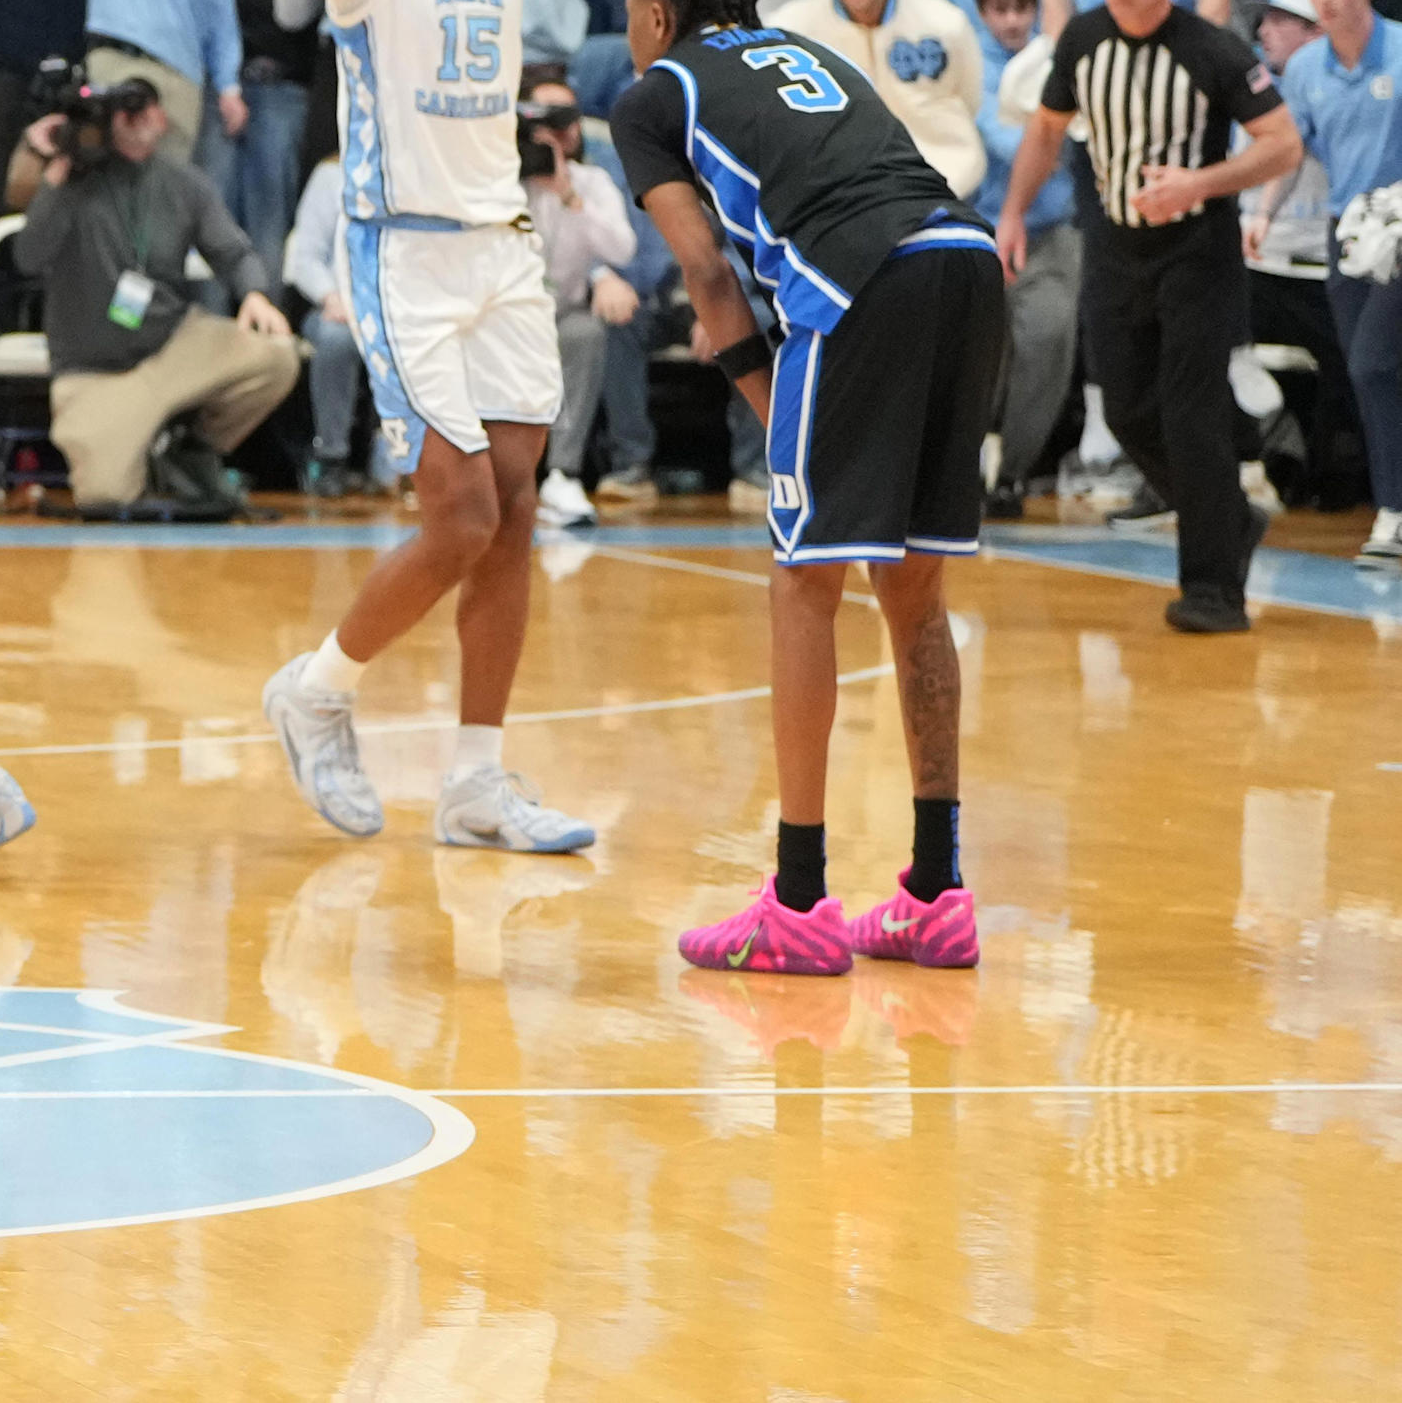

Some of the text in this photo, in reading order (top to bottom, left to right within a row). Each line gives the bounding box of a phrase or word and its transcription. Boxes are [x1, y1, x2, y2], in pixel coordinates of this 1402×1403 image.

[437, 14, 501, 82] 15
[741, 44, 850, 113] 3
[772, 473, 801, 510] D
